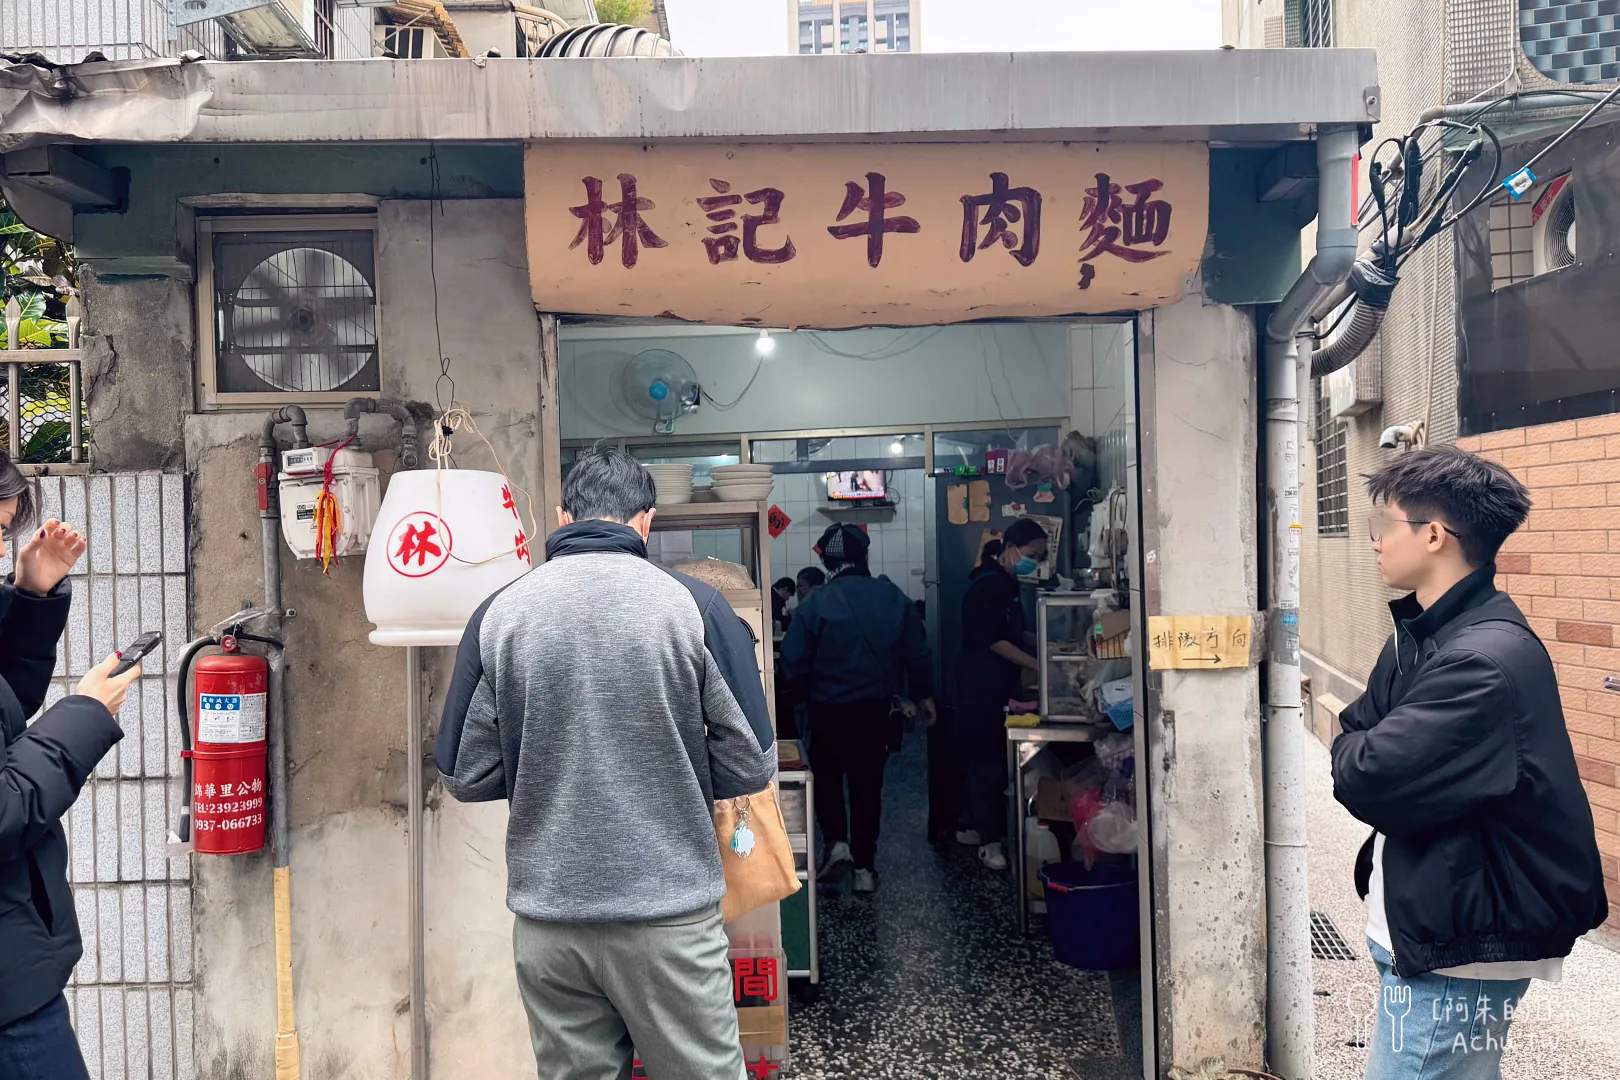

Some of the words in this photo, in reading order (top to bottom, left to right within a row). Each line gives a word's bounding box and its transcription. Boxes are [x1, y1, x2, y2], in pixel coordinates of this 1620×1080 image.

[568, 171, 1173, 269] 林記牛肉麵
[394, 520, 442, 567] 林
[1153, 627, 1246, 651] 排隊方向
[194, 777, 262, 799] 錦華里公物
[194, 796, 263, 814] TEL:23923999
[194, 813, 262, 832] 0937-066733
[734, 957, 778, 1002] 間
